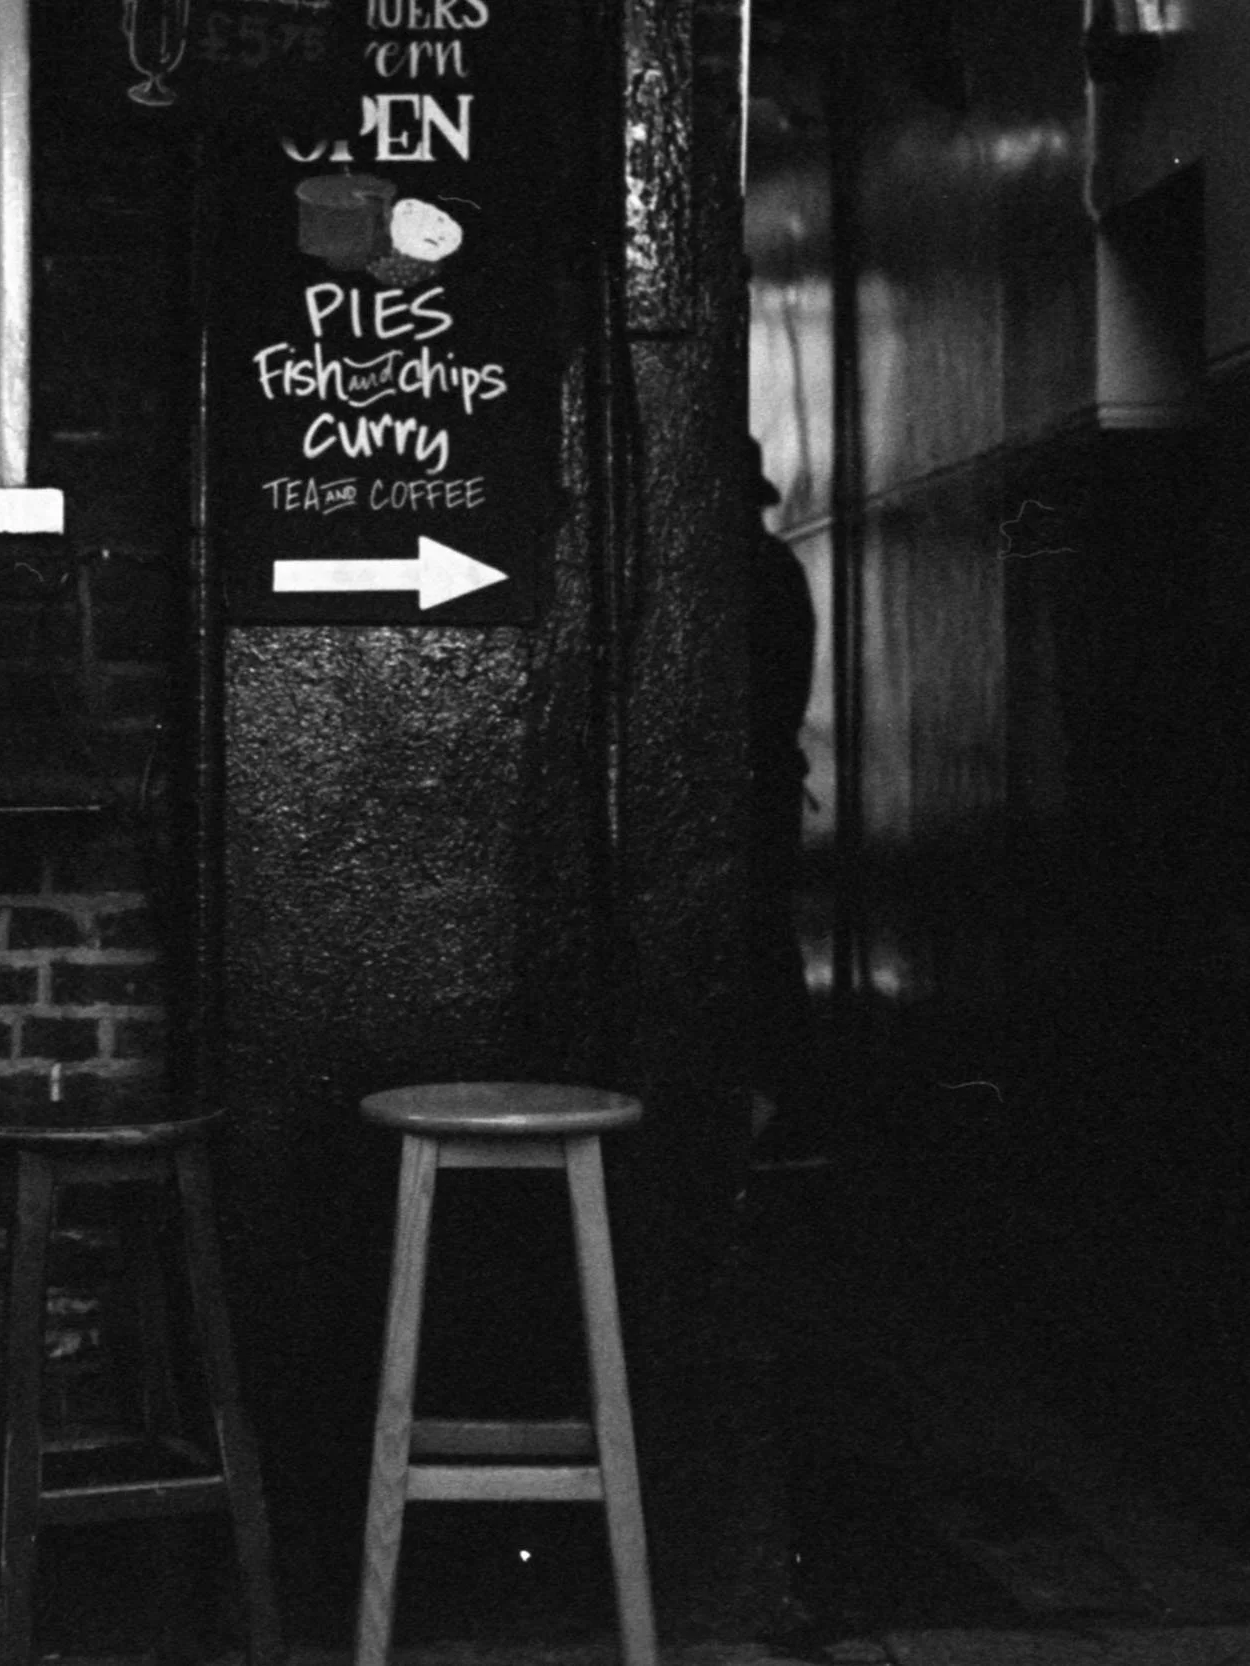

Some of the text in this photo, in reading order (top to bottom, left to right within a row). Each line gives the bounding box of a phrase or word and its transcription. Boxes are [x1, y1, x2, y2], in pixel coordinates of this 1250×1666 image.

[282, 93, 475, 163] EN
[305, 282, 453, 341] PIES
[252, 341, 508, 415] Fish and chips
[262, 475, 486, 511] TEA AND COFFEE
